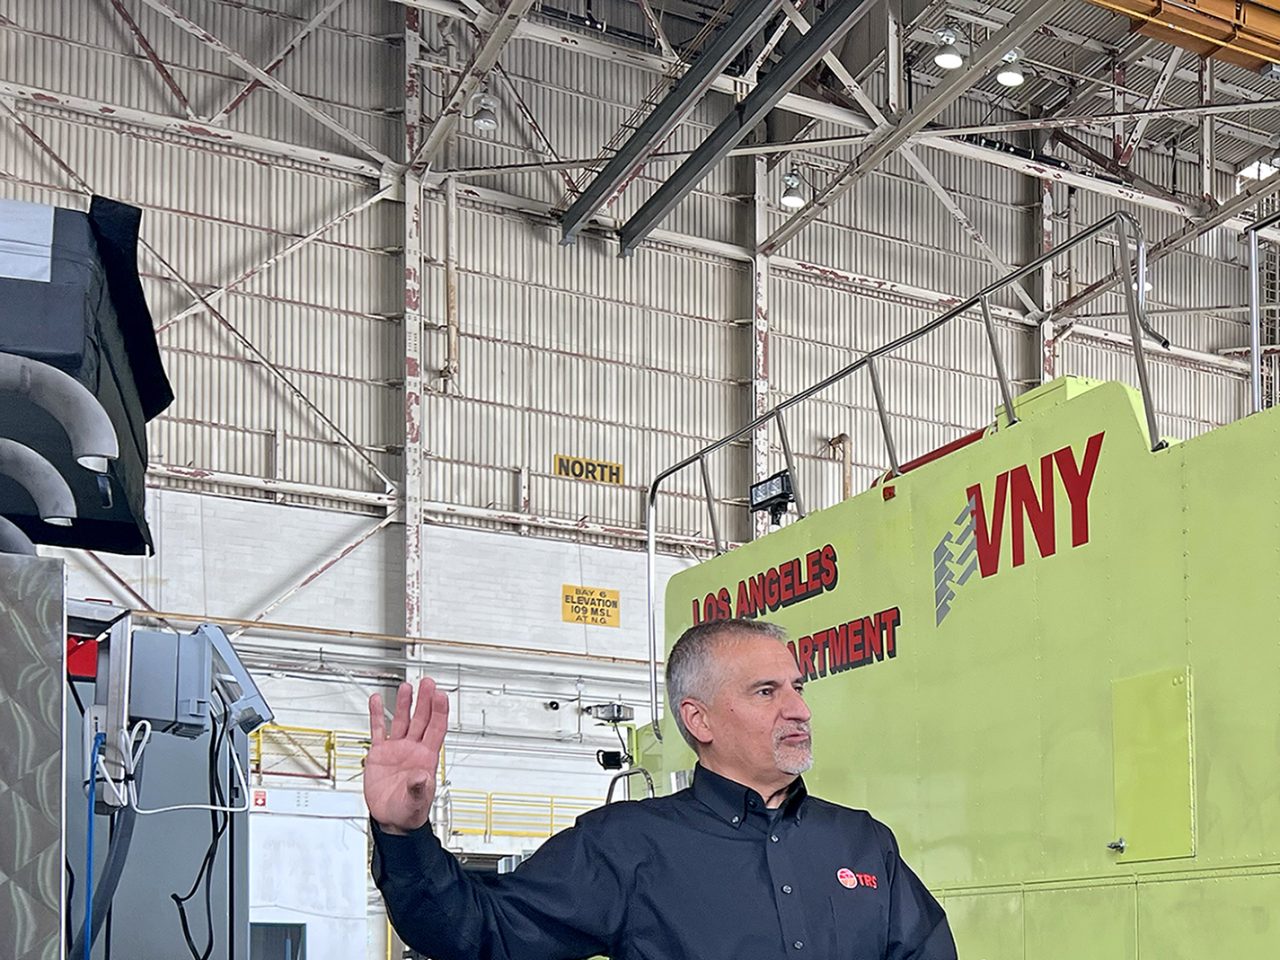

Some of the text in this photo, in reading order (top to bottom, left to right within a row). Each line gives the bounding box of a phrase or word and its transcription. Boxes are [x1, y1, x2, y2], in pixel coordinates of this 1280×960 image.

[558, 457, 620, 483] NORTH
[966, 431, 1105, 578] VNY
[575, 589, 594, 597] BAY
[692, 543, 837, 625] LOS ANGELES
[565, 595, 617, 608] ELEVATION
[571, 605, 612, 618] 109 MSL
[786, 606, 900, 682] ARTMENT
[856, 873, 878, 888] TRS
